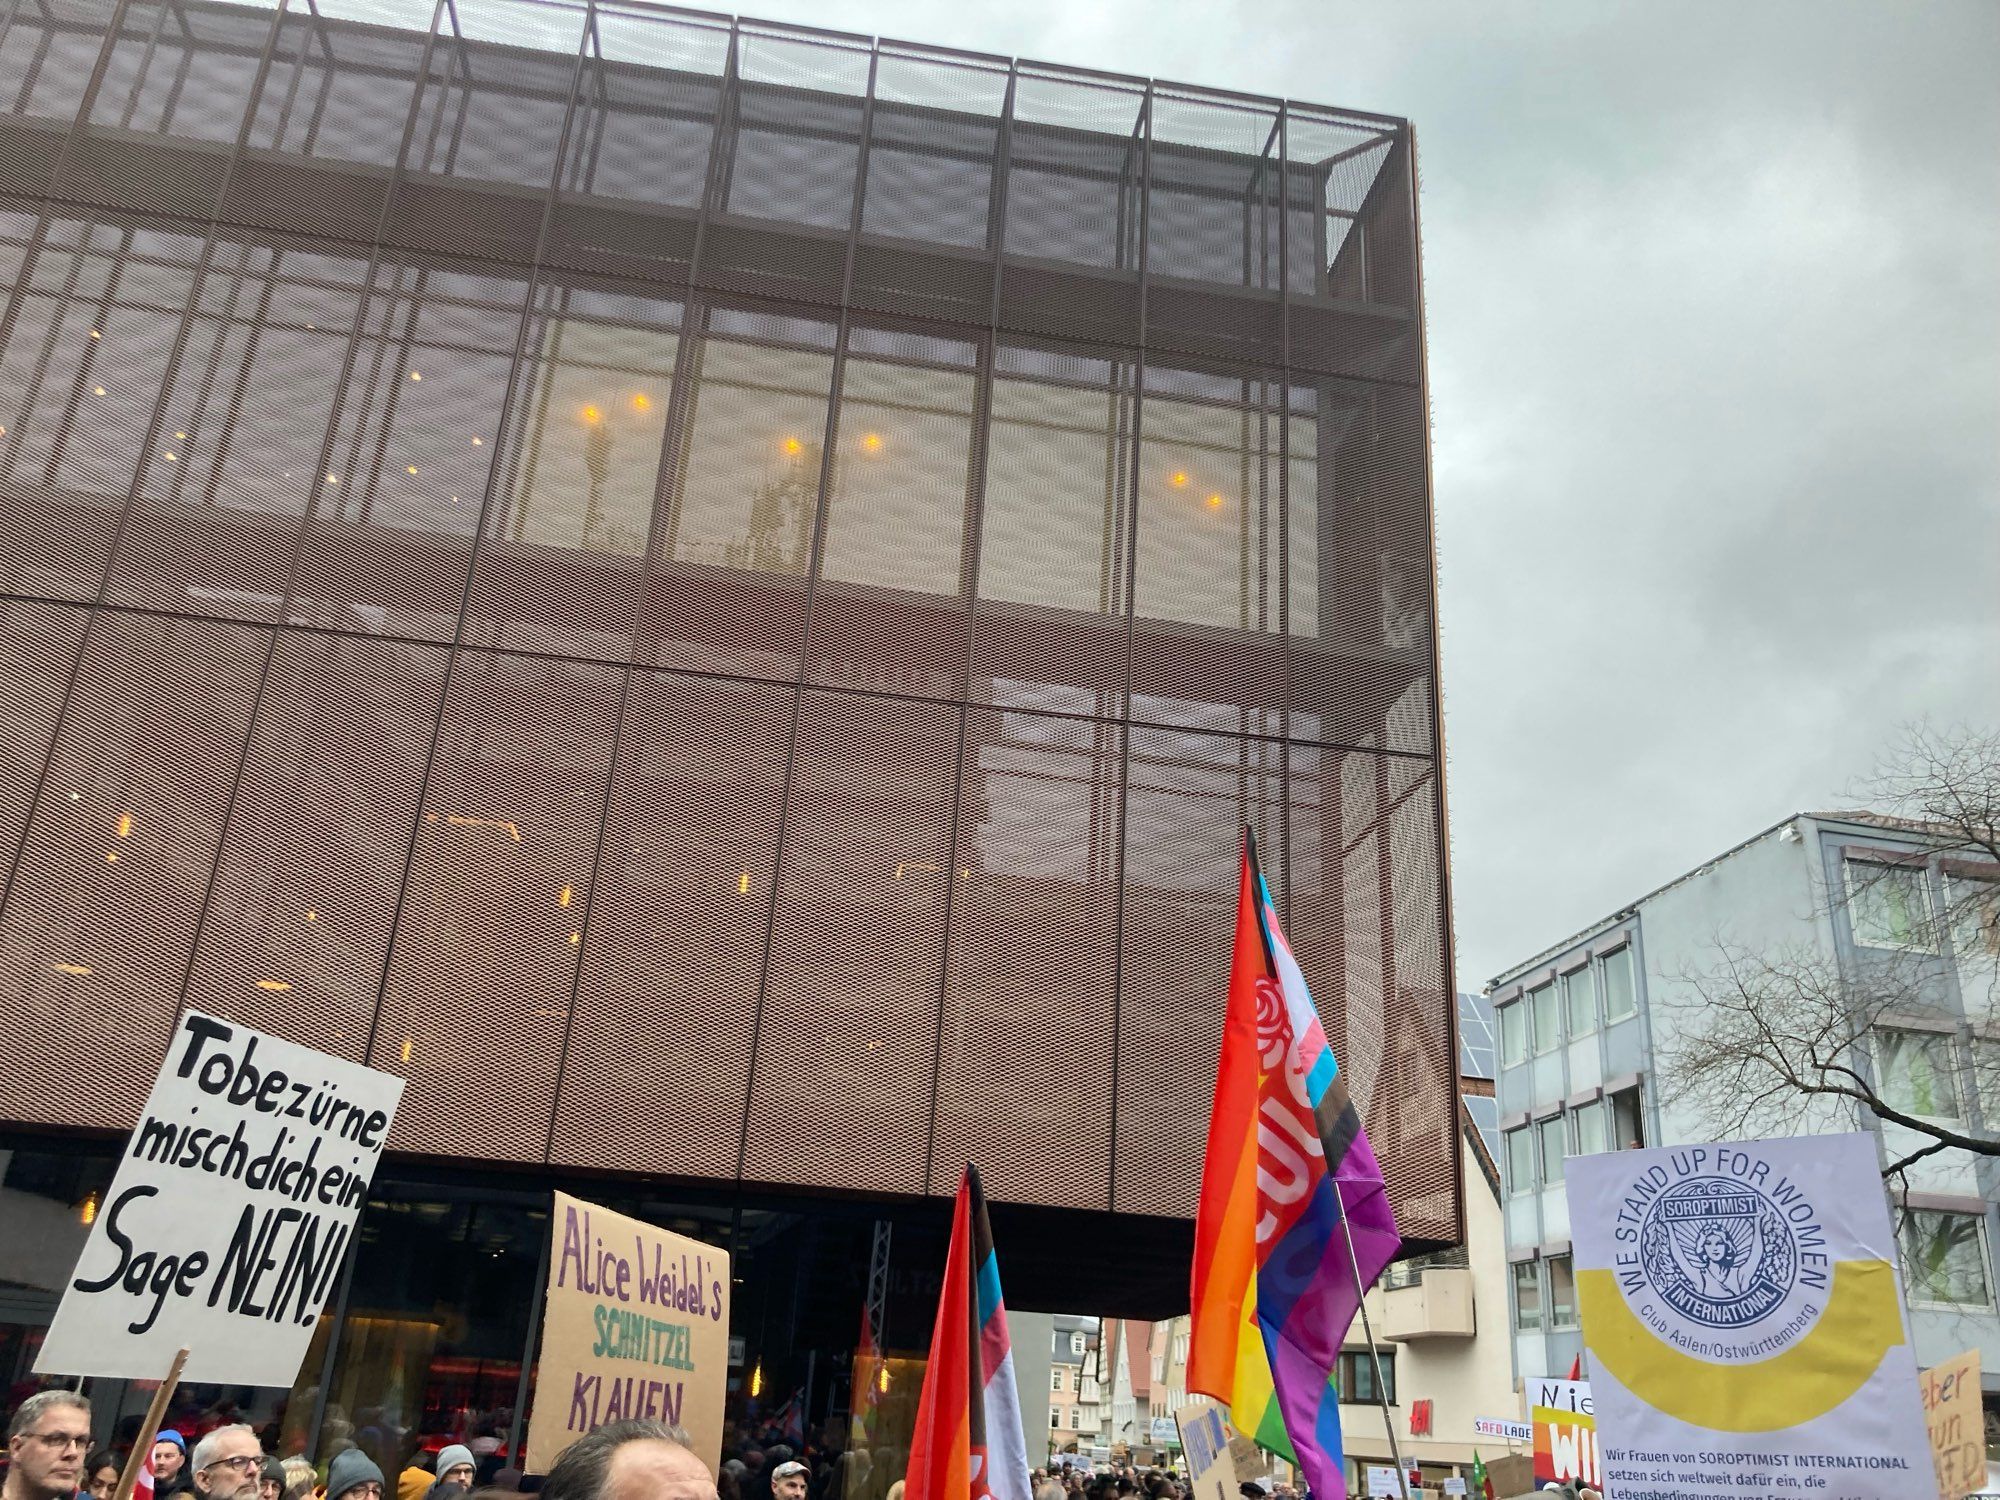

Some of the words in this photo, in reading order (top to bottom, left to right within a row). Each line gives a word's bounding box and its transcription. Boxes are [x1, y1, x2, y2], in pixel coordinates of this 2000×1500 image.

[1671, 1149, 1707, 1176] UP
[1717, 1149, 1770, 1185] FOR
[1615, 1165, 1669, 1243] STAND
[1666, 1198, 1757, 1217] SOROPTIMIST
[1771, 1177, 1828, 1290] WOMEN
[74, 1185, 210, 1334] Sage
[207, 1203, 348, 1327] NEIN!
[557, 1205, 631, 1301] Alice
[636, 1236, 722, 1321] Weidel's
[1615, 1251, 1646, 1296] WE
[1671, 1286, 1777, 1322] INTERNATIONAL
[593, 1304, 695, 1372] SCHNITZEL
[1641, 1304, 1667, 1333] Club
[1670, 1303, 1818, 1359] Aalen/Ostwürttemberg
[1605, 1449, 1626, 1461] Wir
[1629, 1450, 1669, 1463] Frauen
[1672, 1454, 1696, 1464] von
[1699, 1452, 1789, 1467] SOROPTIMIST
[1794, 1455, 1909, 1470] INTERNATIONAL
[1608, 1469, 1648, 1481] setzen
[1650, 1469, 1675, 1483] sich
[1678, 1472, 1734, 1486] weltweit
[1735, 1473, 1772, 1487] dafür
[1776, 1474, 1801, 1489] ein,
[1804, 1475, 1827, 1488] die
